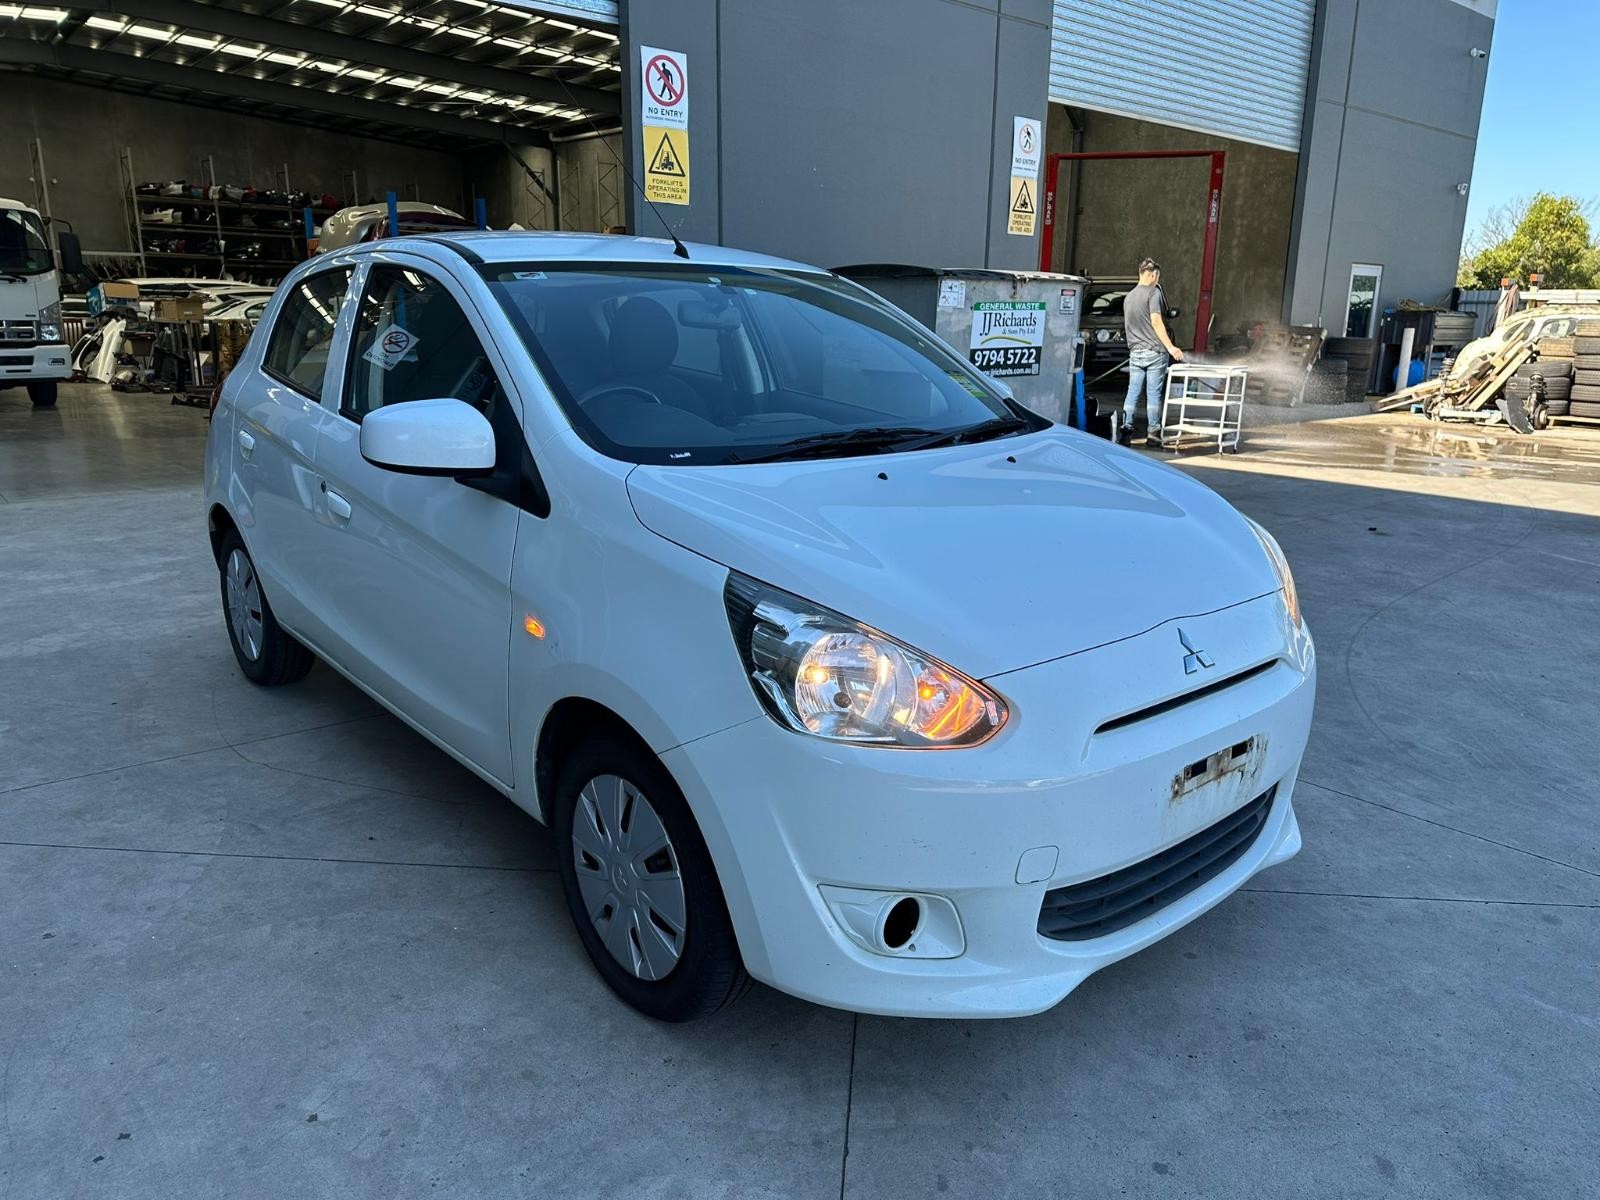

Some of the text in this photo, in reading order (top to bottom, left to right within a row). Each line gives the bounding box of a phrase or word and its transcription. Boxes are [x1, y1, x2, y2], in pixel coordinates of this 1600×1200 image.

[661, 109, 683, 118] ENTRY
[652, 179, 683, 187] FORKLIFTS
[648, 185, 680, 193] OPERATING
[980, 302, 1040, 310] GENERAL WASTE
[975, 348, 1037, 366] 9794 5722
